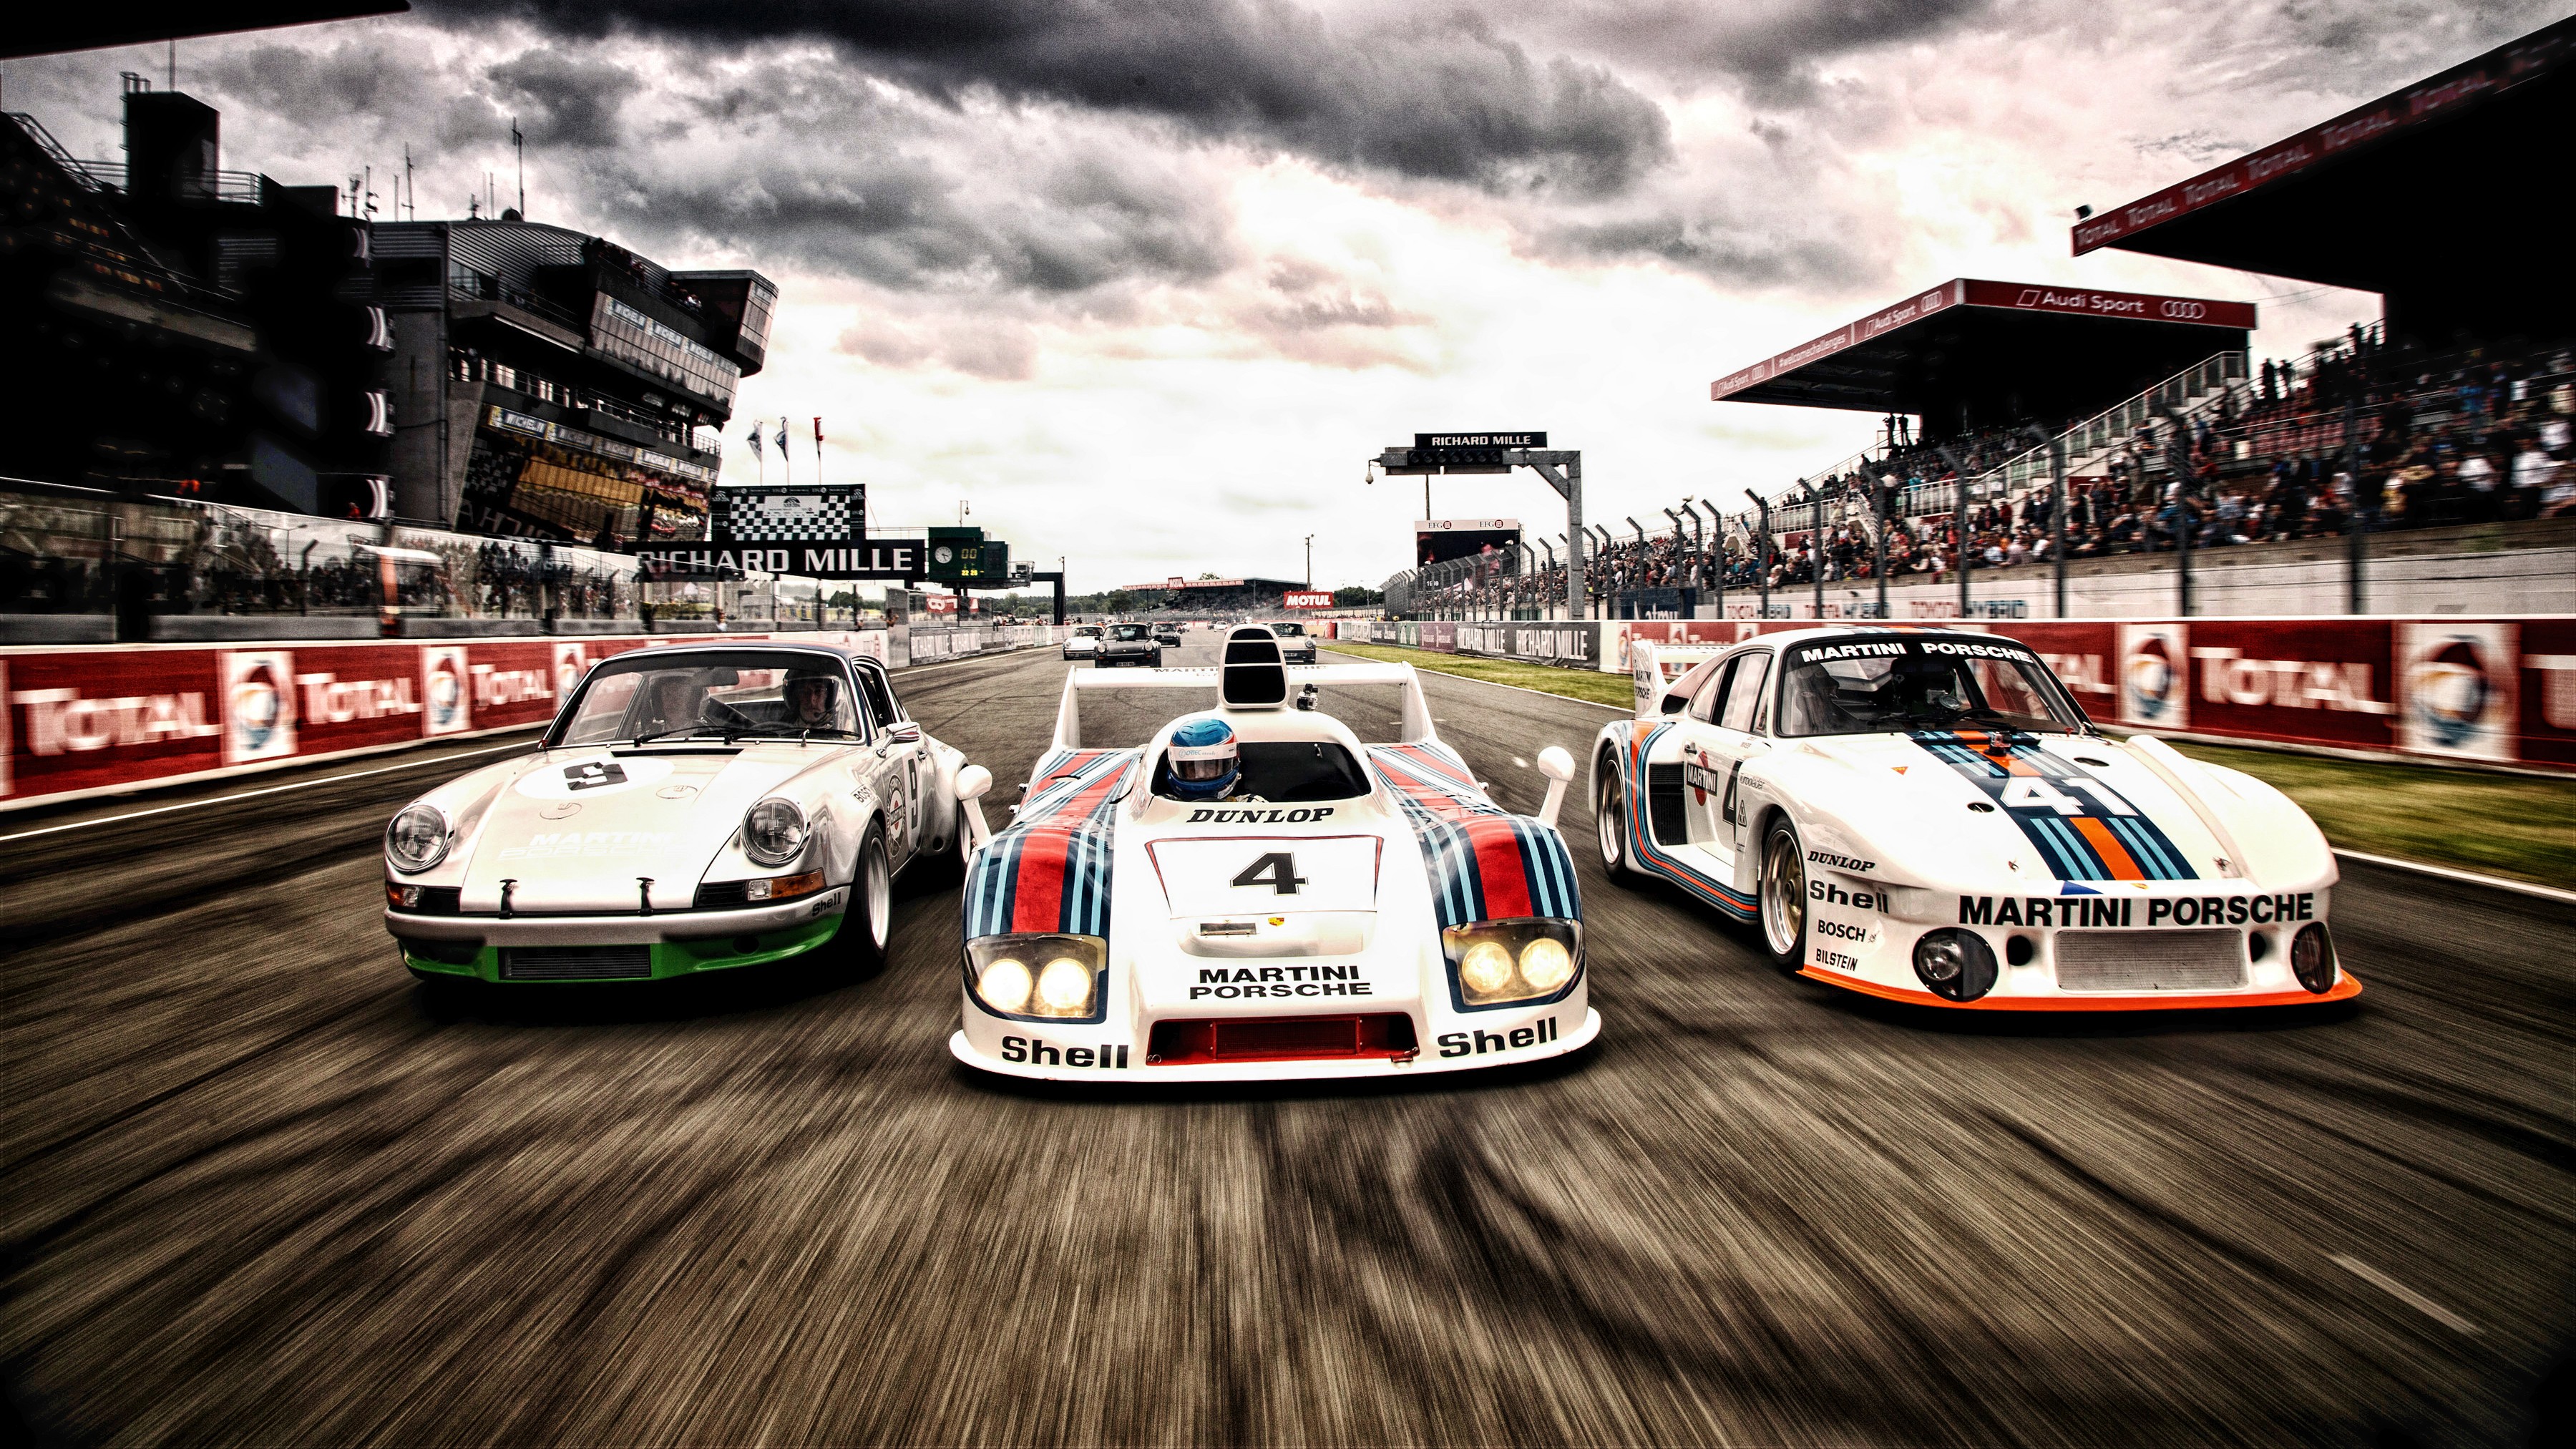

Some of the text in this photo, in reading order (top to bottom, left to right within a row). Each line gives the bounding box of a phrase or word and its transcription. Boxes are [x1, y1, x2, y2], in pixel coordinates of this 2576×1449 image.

[2245, 144, 2313, 179] TOTAL
[2182, 173, 2241, 205] TOTAL
[2126, 197, 2177, 227] TOTAL
[2075, 220, 2122, 247] TOTAL
[1873, 303, 1916, 329] Audi Sport
[2041, 291, 2145, 313] Audi Sport
[1432, 435, 1531, 447] RICHARD MILLE
[635, 548, 913, 574] RICHARD MILLE
[1286, 595, 1331, 606] MOTUL
[1457, 628, 1483, 650] RICHARD
[1484, 629, 1505, 653] MILLE
[1516, 630, 1588, 660] RICHARD MILLE
[1801, 643, 2034, 663] MARTINI PORSCHE
[469, 664, 554, 711] TOTAL
[2190, 646, 2398, 715] TOTAL
[296, 673, 424, 724] TOTAL
[10, 687, 225, 757] TOTAL
[563, 762, 628, 791] 9
[1687, 764, 1717, 792] MARTINI
[908, 758, 918, 830] 9
[1999, 776, 2140, 816] 41
[1186, 807, 1335, 824] DUNLOP
[1229, 852, 1309, 896] 4
[1807, 850, 1875, 872] DUNLOP
[811, 892, 841, 917] Shell
[1810, 879, 1889, 914] Shell
[1958, 892, 2315, 927] MARTINI PORSCHE
[1818, 919, 1866, 942] BOSCH
[1815, 948, 1858, 972] BILSTEIN
[1199, 965, 1360, 984] MARTINI
[1189, 982, 1373, 1000] PORSCHE
[1438, 1016, 1559, 1059] Shell
[1000, 1035, 1129, 1070] Shell
